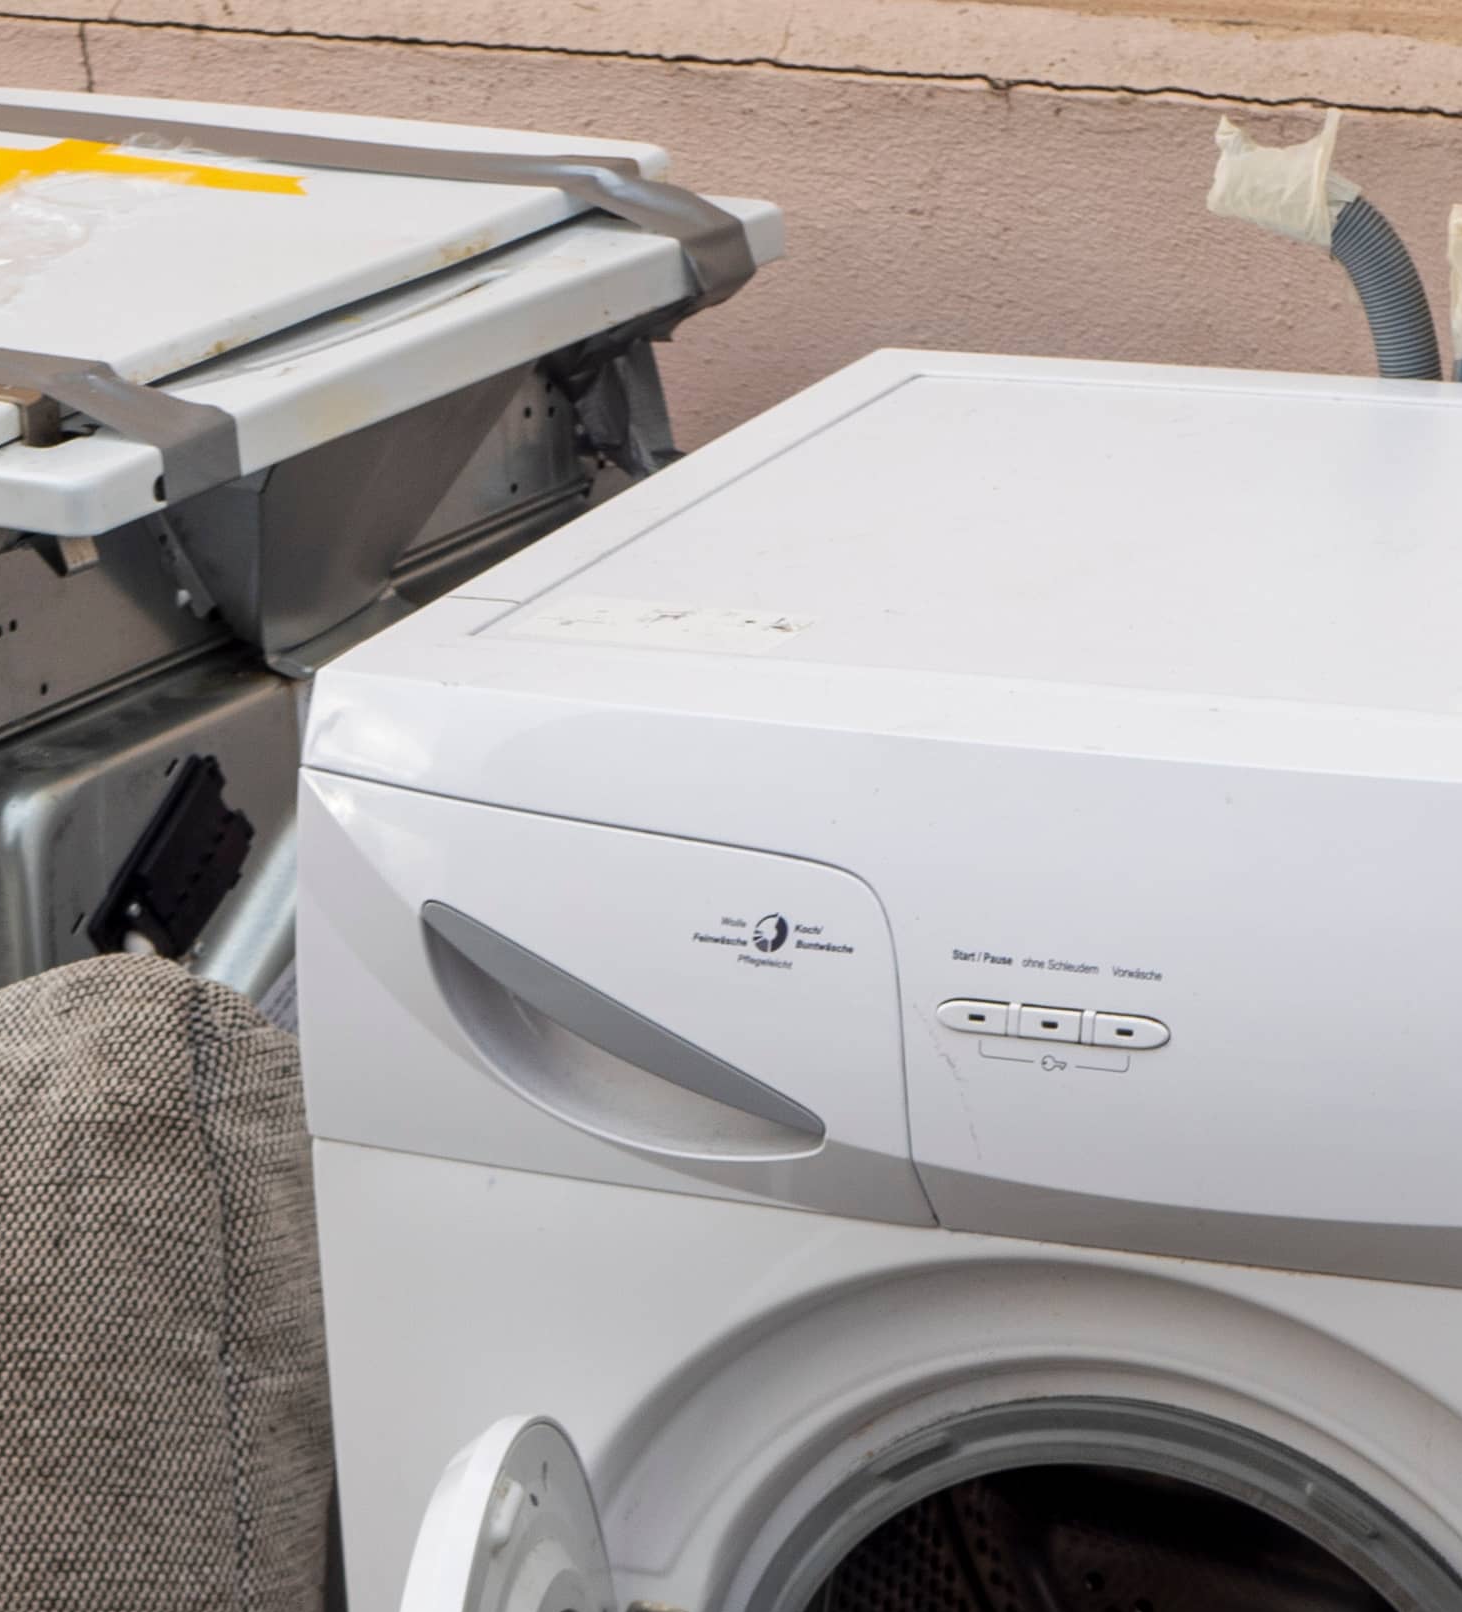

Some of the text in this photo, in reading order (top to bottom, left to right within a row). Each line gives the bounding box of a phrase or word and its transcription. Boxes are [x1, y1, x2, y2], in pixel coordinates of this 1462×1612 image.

[795, 939, 854, 954] Buntwäsche
[952, 949, 975, 962] Start
[983, 952, 1013, 966] Pause
[1022, 957, 1099, 975] ohne Schleudern
[1112, 965, 1162, 981] Vorwäsche
